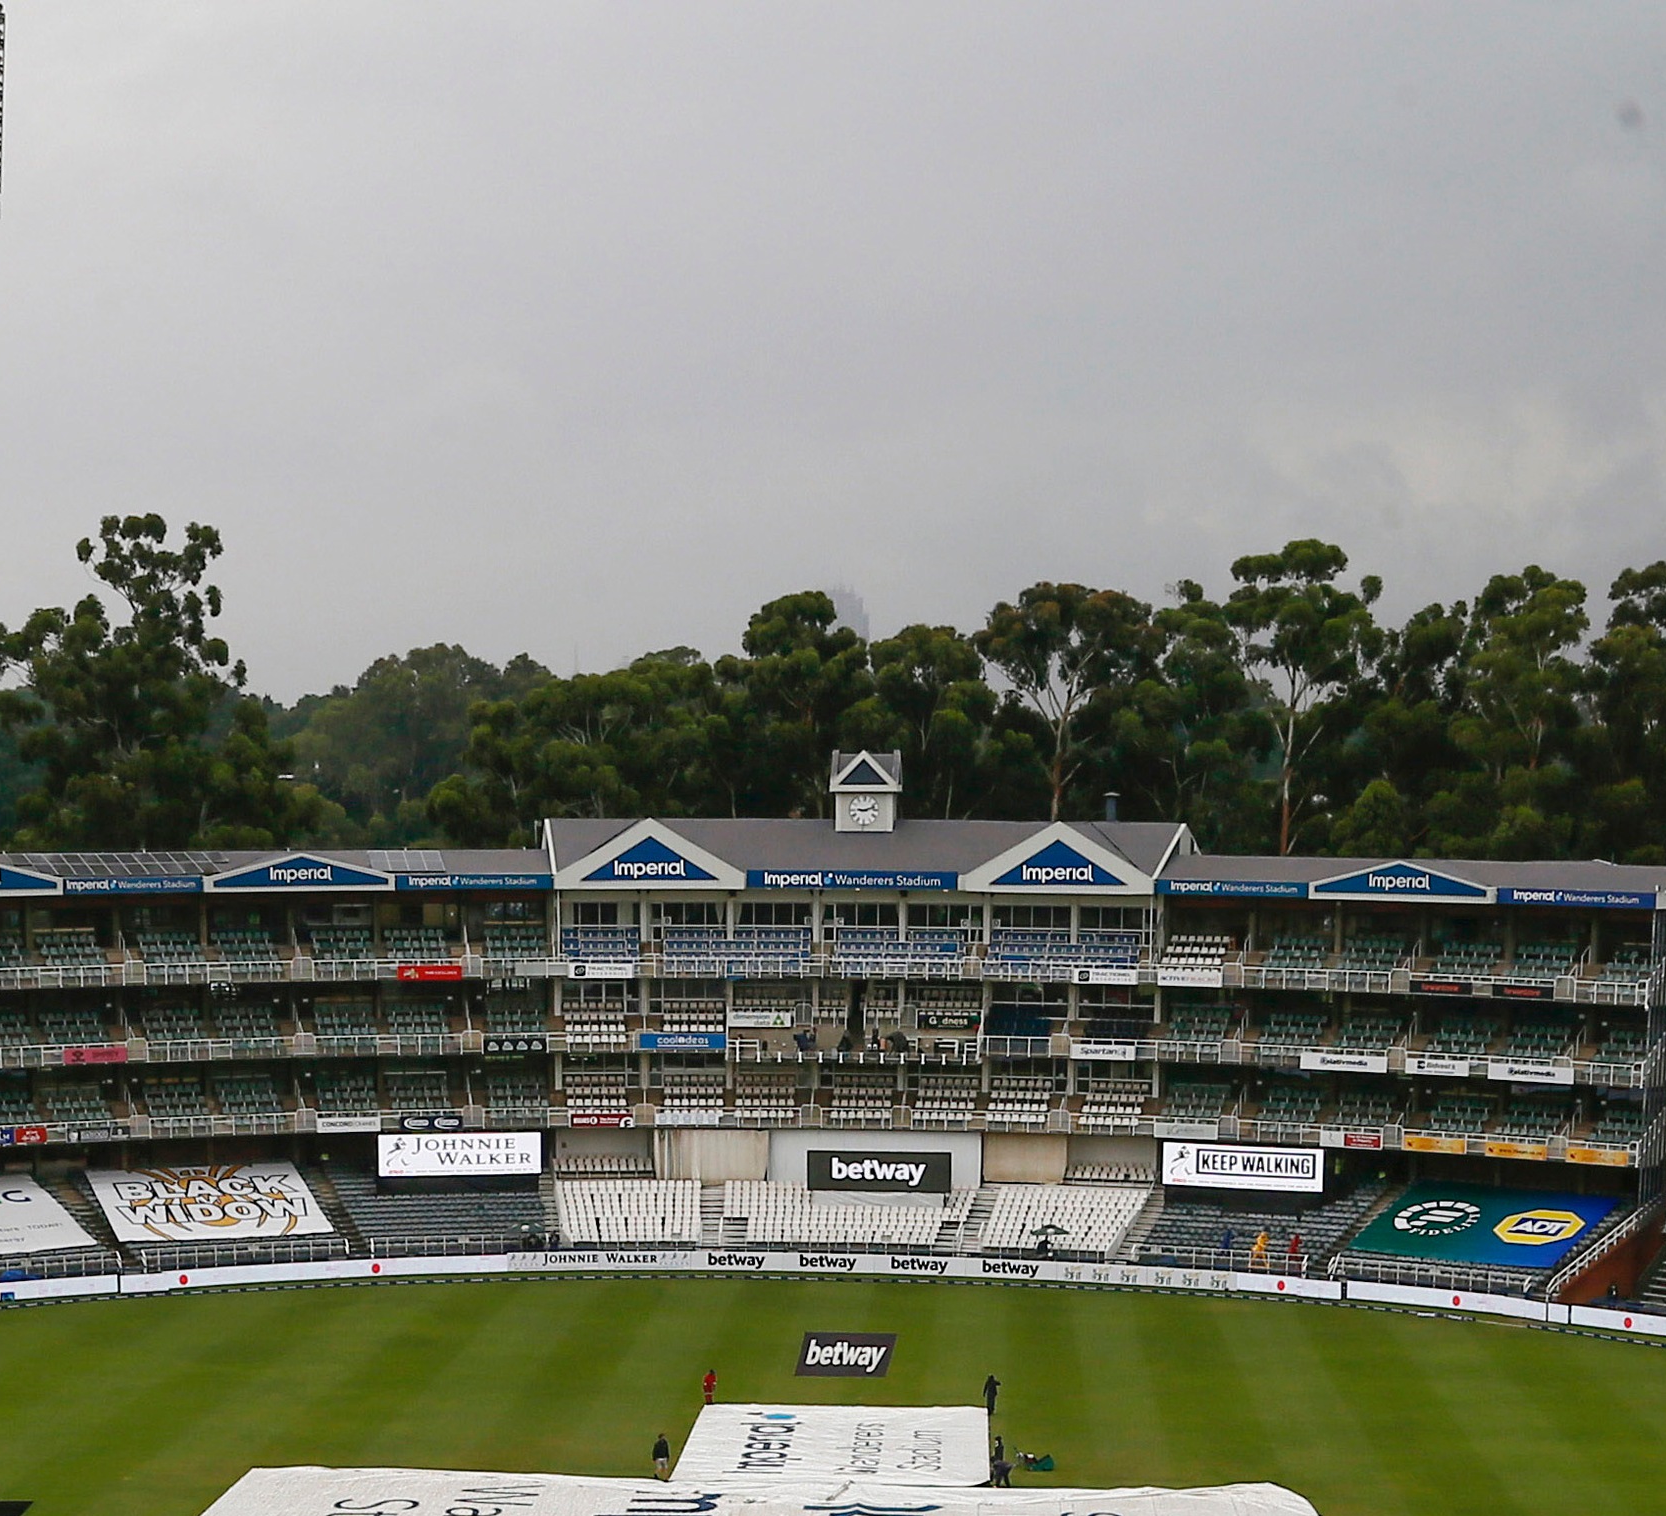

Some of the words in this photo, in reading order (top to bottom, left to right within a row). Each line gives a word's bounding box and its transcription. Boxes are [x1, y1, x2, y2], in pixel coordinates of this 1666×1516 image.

[270, 865, 333, 882] Imperial
[614, 859, 685, 879] Imperial
[1022, 863, 1094, 885] Imperial
[66, 877, 110, 892] Imperial
[118, 878, 160, 889] Wanderers
[163, 877, 197, 888] Stadium
[408, 874, 453, 888] Imperial
[460, 875, 501, 886] Wanderers
[504, 875, 537, 885] Stadium
[764, 871, 823, 888] Imperial
[835, 873, 893, 887] Wanderers
[896, 874, 941, 888] Stadium
[1170, 880, 1214, 894] Imperial
[1221, 882, 1262, 893] Wanderers
[1265, 882, 1298, 893] Stadium
[1368, 872, 1430, 892] Imperial
[1513, 888, 1556, 903] Imperial
[1563, 891, 1603, 904] Wanderers
[1606, 893, 1640, 904] Stadium
[412, 1138, 516, 1156] JOHNNIE
[437, 1152, 532, 1166] WALKER
[1201, 1155, 1238, 1170] KEEP
[1241, 1155, 1312, 1175] WALKING
[831, 1156, 927, 1186] betway
[114, 1172, 294, 1203] BLACK
[116, 1197, 308, 1227] WIDOW
[1512, 1221, 1567, 1236] ADT
[543, 1253, 599, 1266] JOHNNIE
[606, 1252, 658, 1264] WALKER
[708, 1253, 765, 1269] betway
[800, 1254, 857, 1271] betway
[891, 1256, 948, 1274] betway
[982, 1260, 1039, 1278] betway
[805, 1340, 887, 1372] betway
